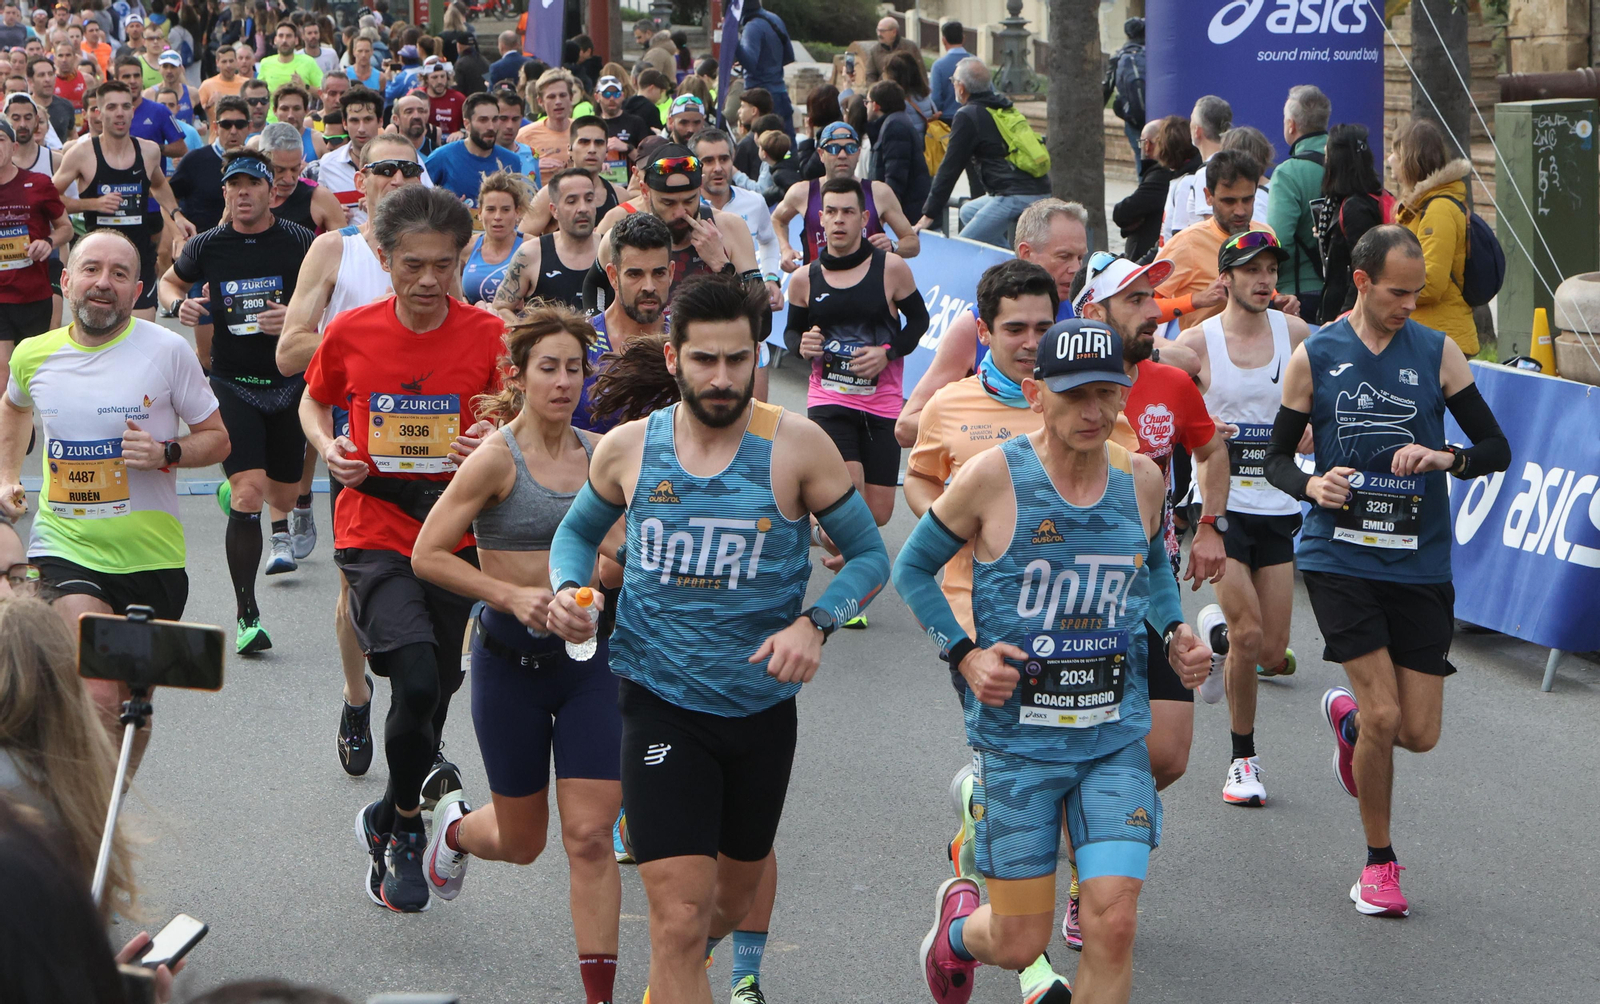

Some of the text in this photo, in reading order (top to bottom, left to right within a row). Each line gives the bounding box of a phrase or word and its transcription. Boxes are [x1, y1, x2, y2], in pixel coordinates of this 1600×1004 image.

[1257, 47, 1379, 63] sound mind, sound body
[113, 185, 138, 193] ZURICH
[0, 228, 23, 237] URICH
[0, 242, 14, 251] 019
[241, 279, 276, 291] ZURICH
[242, 298, 264, 310] 2809
[244, 313, 259, 323] JES
[1076, 352, 1099, 360] SPORTS
[827, 371, 854, 384] ANTONIO
[97, 405, 141, 415] gasNatural
[400, 399, 449, 411] ZURICH
[1143, 413, 1171, 427] Chupa
[399, 424, 430, 437] 3936
[1143, 424, 1171, 442] Chups
[1244, 428, 1273, 437] ZURIC
[66, 444, 113, 456] ZURICH
[400, 445, 429, 455] TOSHI
[1242, 449, 1266, 460] 2460
[1239, 466, 1264, 475] XAVIE
[68, 471, 95, 483] 4487
[1369, 476, 1416, 490] ZURICH
[69, 490, 101, 501] RUBÉN
[1366, 500, 1394, 514] 3281
[1362, 519, 1395, 532] EMILIO
[675, 576, 721, 590] SPORTS
[1060, 618, 1103, 630] SPORTS
[1061, 637, 1118, 652] ZURICH
[1059, 669, 1095, 685] 2034
[1033, 690, 1115, 707] COACH SERGIO
